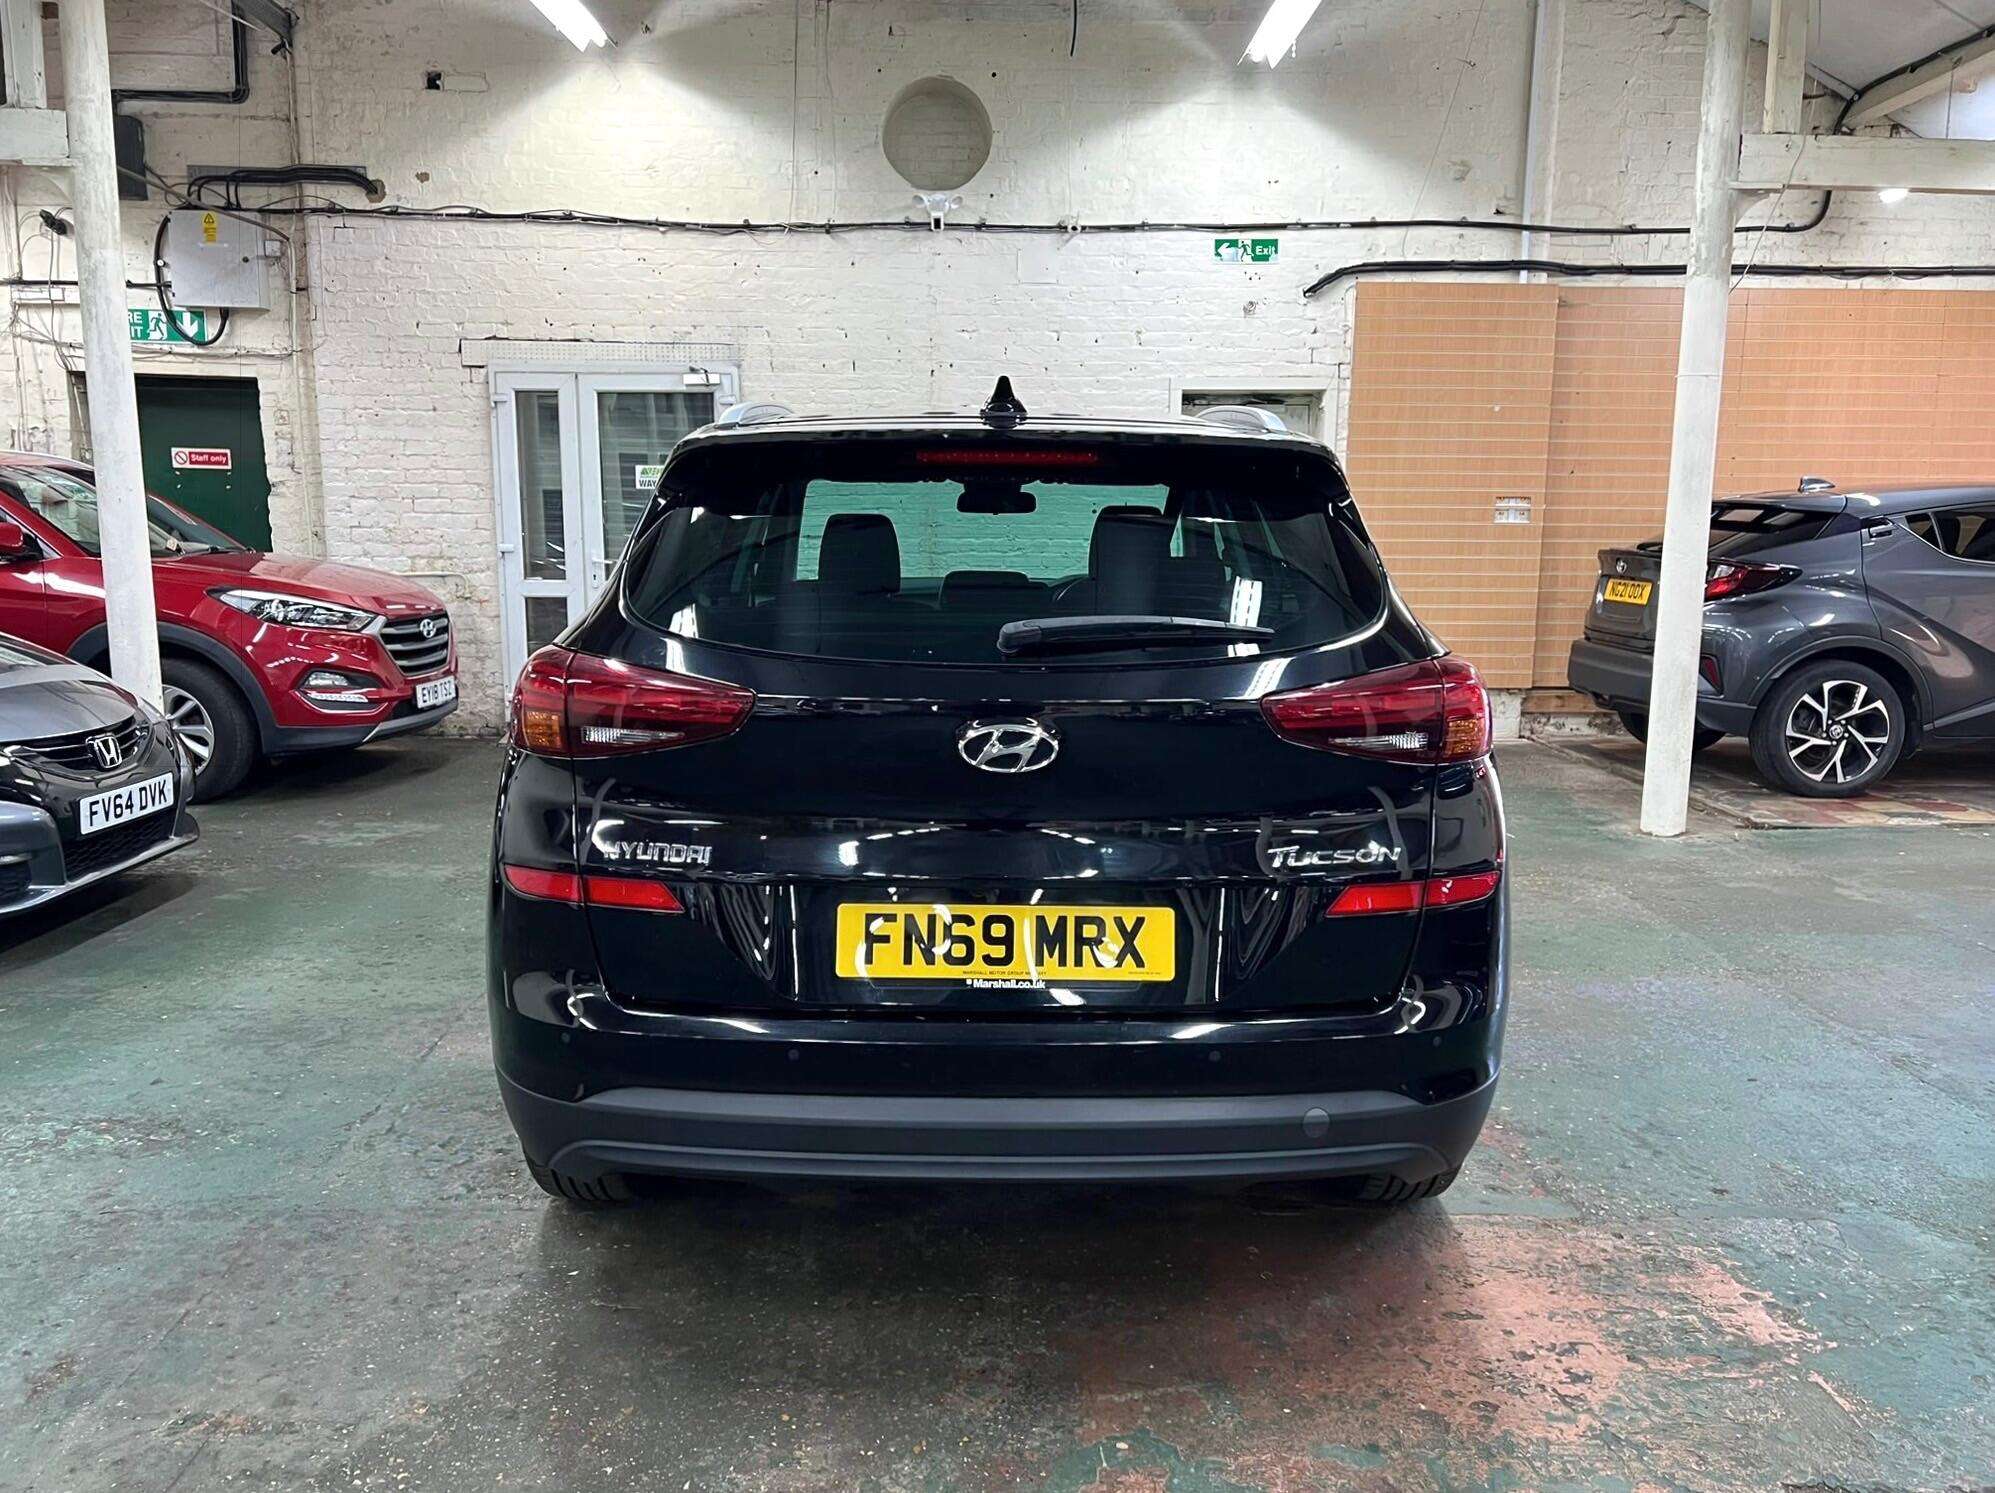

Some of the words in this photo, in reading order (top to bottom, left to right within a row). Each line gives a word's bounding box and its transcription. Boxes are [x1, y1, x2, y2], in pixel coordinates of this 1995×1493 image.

[1255, 245, 1276, 256] Exit
[128, 312, 143, 323] RE
[130, 326, 144, 338] IT
[191, 454, 209, 462] Staff
[210, 455, 226, 464] only
[639, 479, 657, 488] WAY
[89, 790, 134, 826] FV64
[138, 780, 167, 811] DVK
[603, 841, 712, 864] HYUNDAI
[864, 913, 1015, 967] FN69
[1035, 915, 1146, 969] MRX
